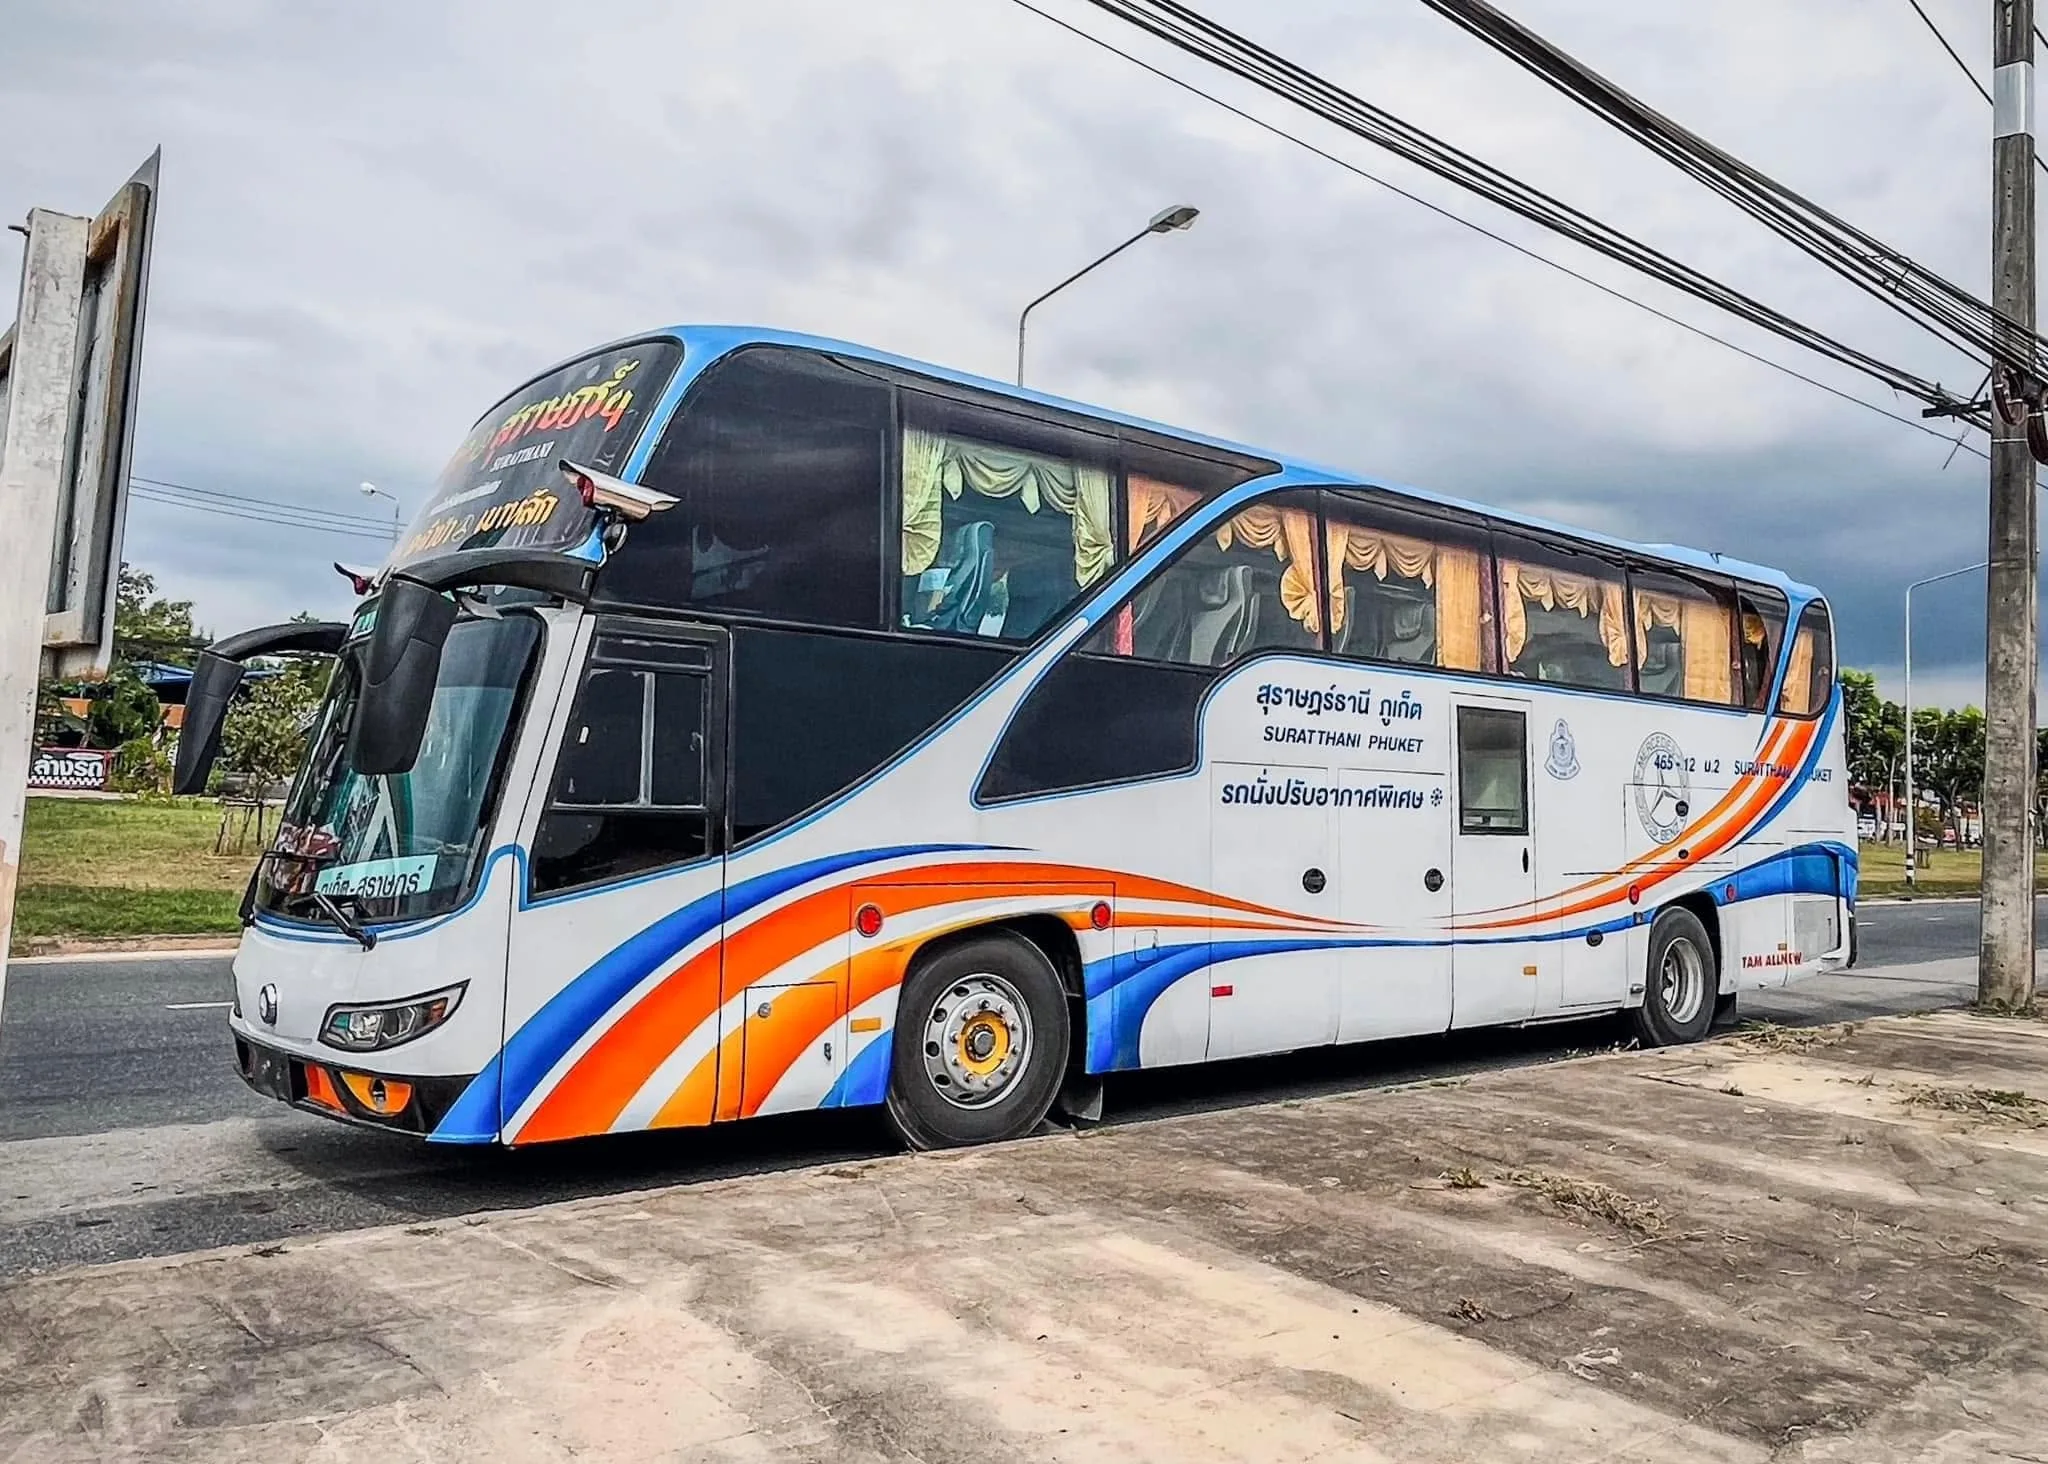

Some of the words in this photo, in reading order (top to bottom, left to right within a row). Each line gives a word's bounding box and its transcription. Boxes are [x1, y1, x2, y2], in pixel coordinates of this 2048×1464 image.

[1256, 684, 1371, 716] สุราษฎร์ธานี
[1379, 690, 1423, 726] ภูเก็ต
[1263, 725, 1361, 748] SURATTHANI
[1368, 735, 1424, 753] PHUKET
[1221, 768, 1424, 809] รถนั่งปรับอากาศพิเศษ
[1742, 955, 1762, 969] TAM
